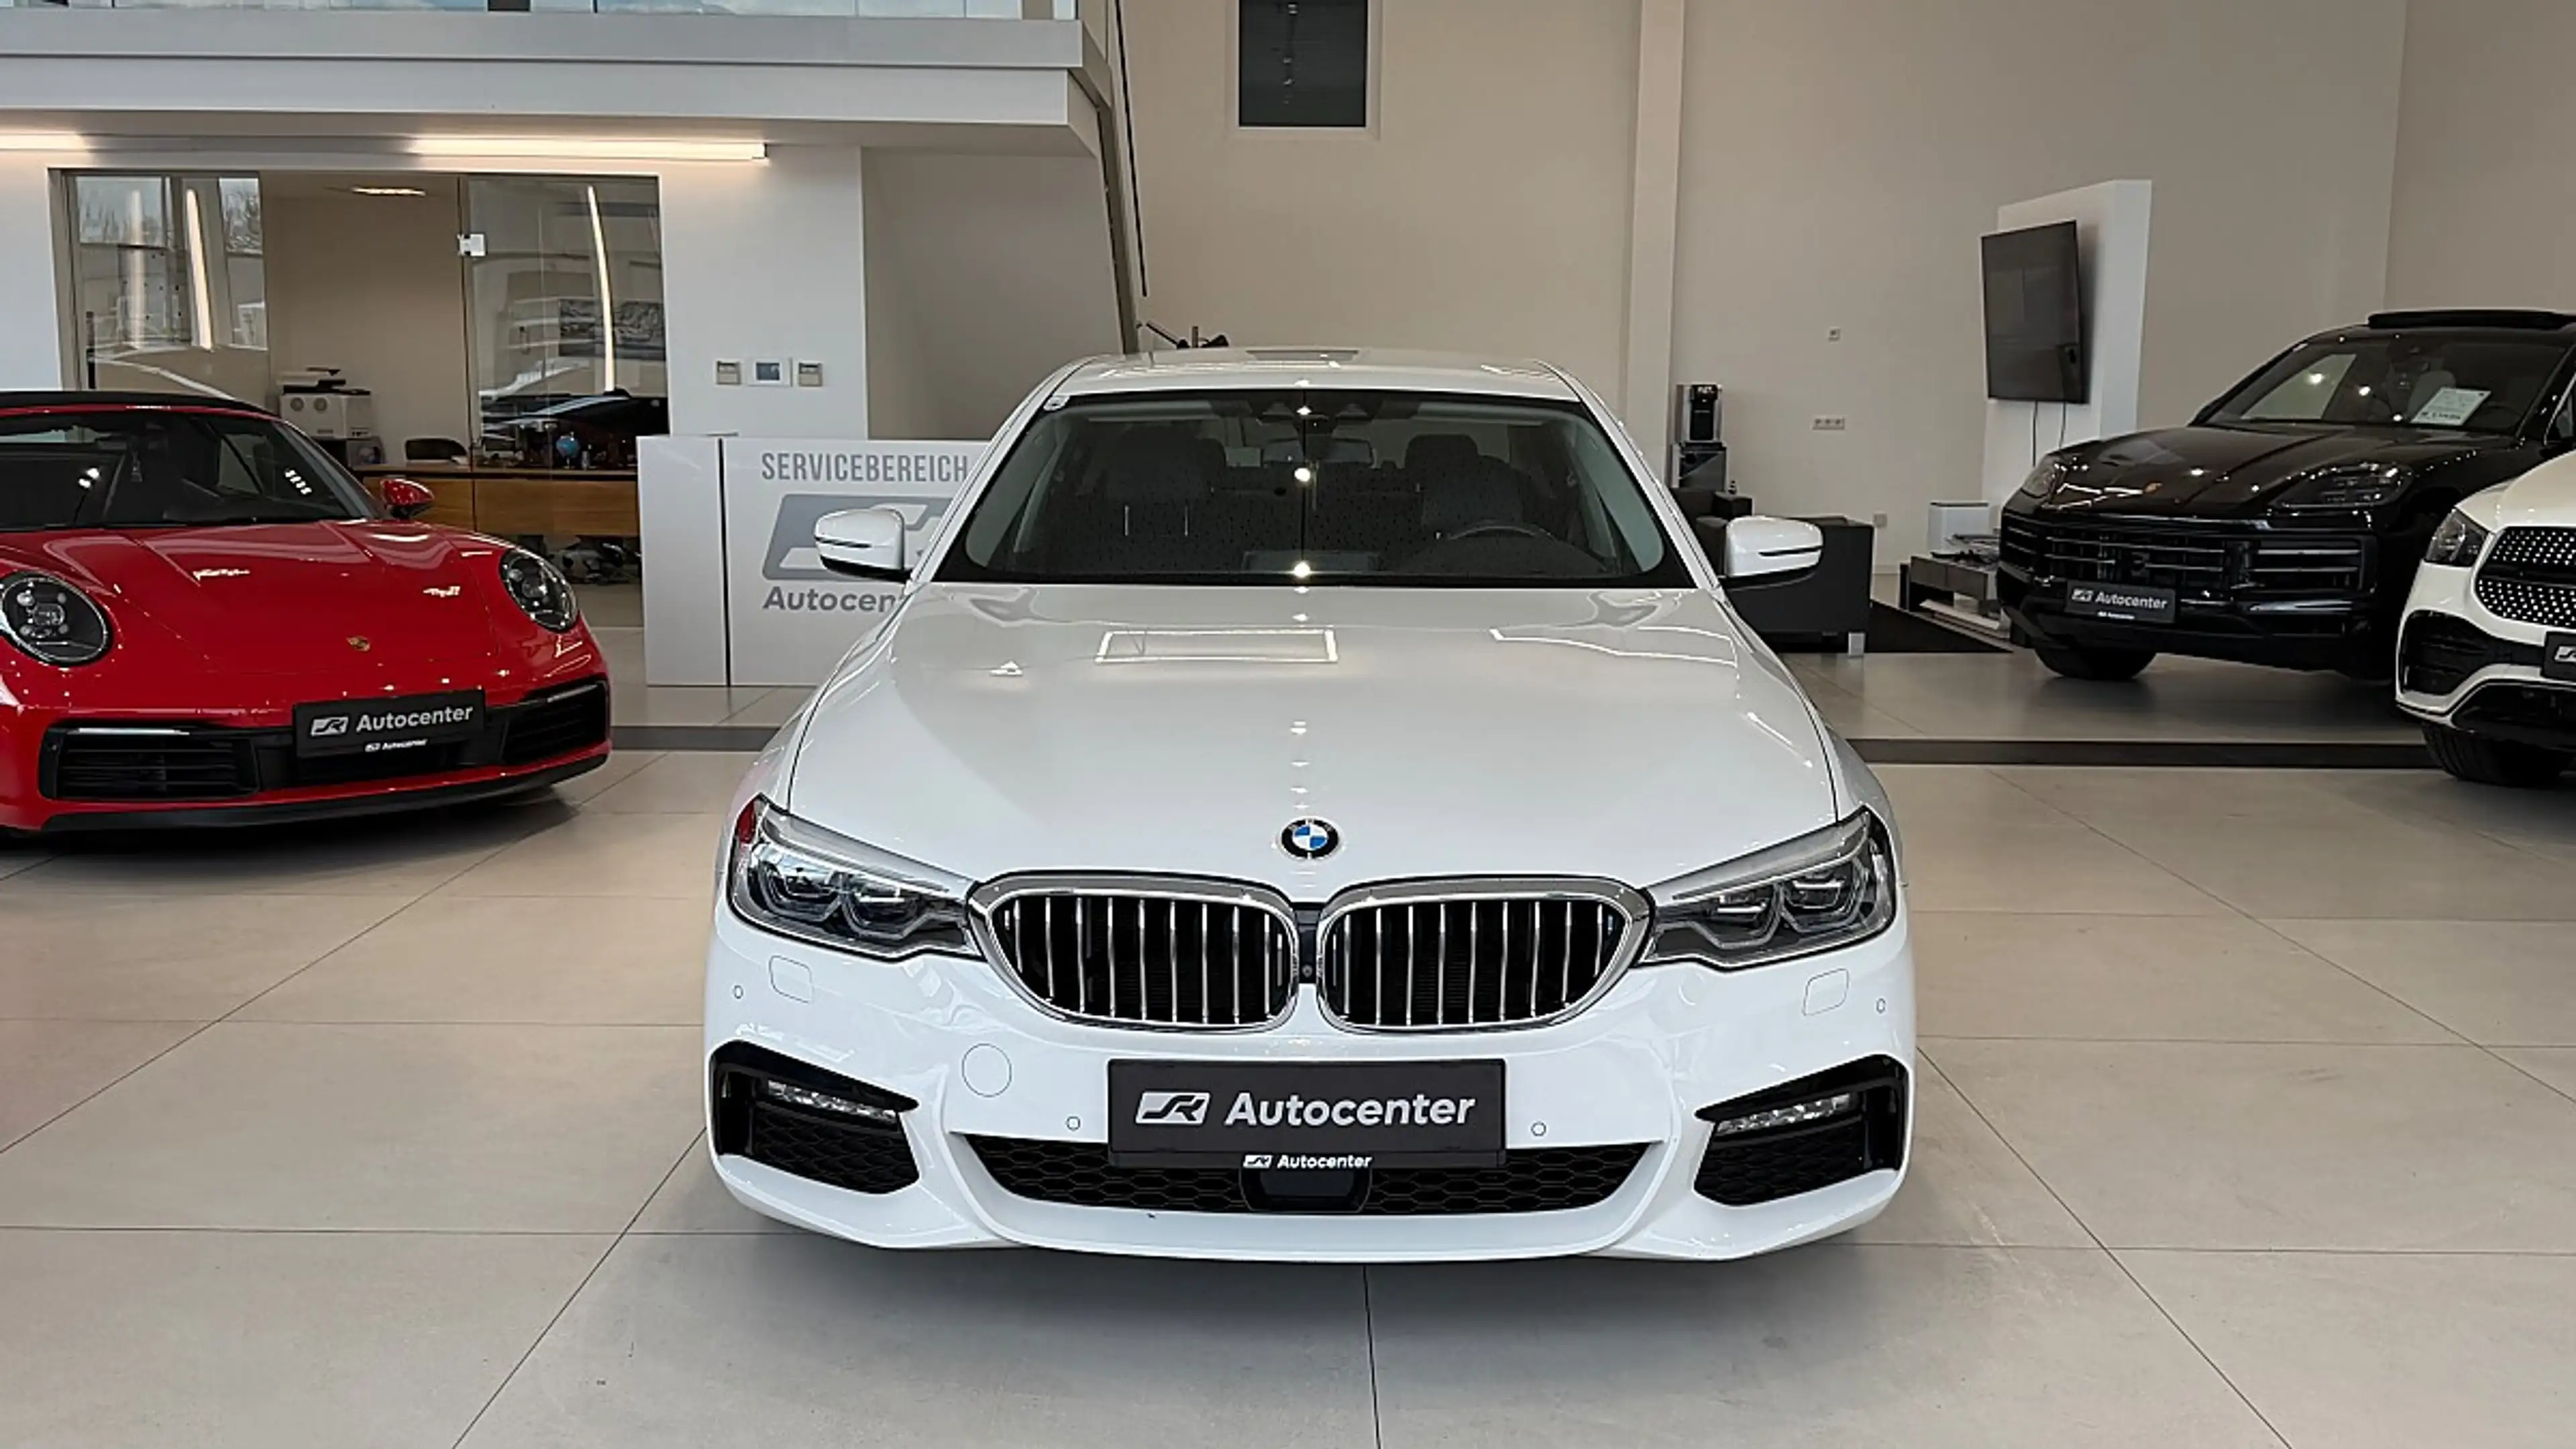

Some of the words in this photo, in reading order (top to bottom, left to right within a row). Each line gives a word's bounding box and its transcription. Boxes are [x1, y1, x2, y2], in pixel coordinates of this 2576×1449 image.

[761, 453, 967, 482] SERVICEBEREICH
[2095, 591, 2167, 609] Autocenter
[356, 706, 473, 732] Autocenter
[1224, 1092, 1476, 1126] Autocenter
[1277, 1155, 1373, 1169] Autocenter
